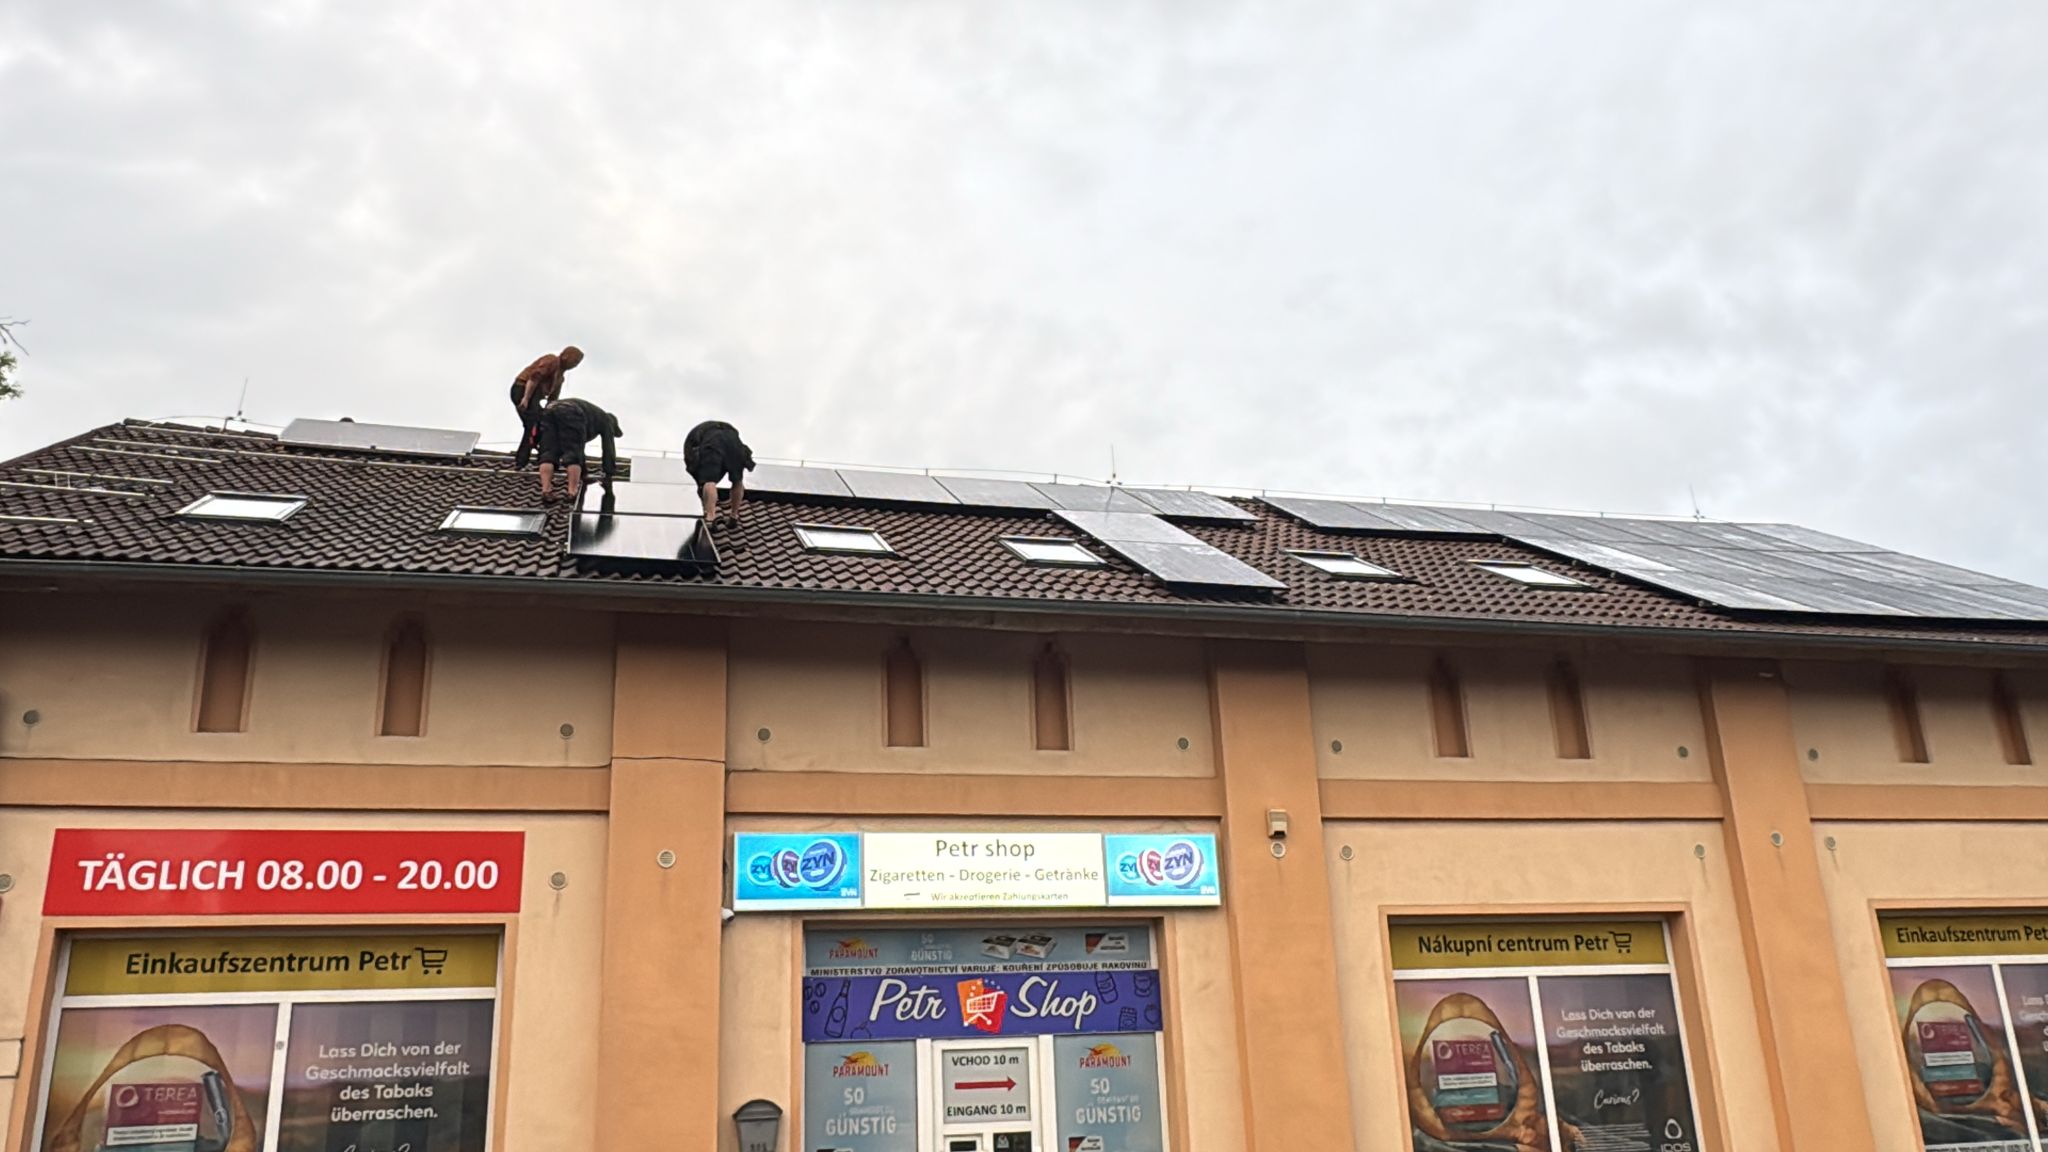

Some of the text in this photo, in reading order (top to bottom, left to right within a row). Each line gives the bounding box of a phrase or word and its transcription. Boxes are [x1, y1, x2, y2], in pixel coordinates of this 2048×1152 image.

[935, 838, 1036, 862] Petr shop
[801, 851, 836, 872] ZYN
[1163, 851, 1194, 871] ZYN
[78, 852, 499, 891] TÄGLICH 08.00 - 20.00
[869, 868, 946, 885] Zigaretten
[959, 868, 1022, 885] Drogerie
[1034, 867, 1099, 882] Getränke
[930, 891, 1069, 902] Wir akzeptieren Zahlungskarten
[1895, 926, 2022, 944] Einkaufszentrum
[829, 947, 879, 960] PARAMOUNT
[1417, 934, 1609, 956] Nákupní centrum Petr
[126, 950, 412, 975] Einkaufszentrum Petr
[810, 960, 1148, 976] MINISTERSTVO ZDRAVOTNICTVÍ VARUJE: KOUŘENÍ ZPŮSOBUJE RAKOVINU
[869, 975, 1098, 1030] Petr Shop
[1561, 1007, 1657, 1021] Lass Dich von der
[1556, 1022, 1666, 1039] Geschmacksvielfalt
[319, 1041, 462, 1059] Lass Dich von der
[1582, 1040, 1646, 1055] des Tabaks
[951, 1054, 1020, 1067] VCHOD 10 m
[1079, 1055, 1131, 1069] PARAMOUNT
[1580, 1058, 1653, 1072] überraschen.
[305, 1060, 471, 1081] Geschmacksvielfalt
[833, 1063, 889, 1078] PARAMOUNT
[144, 1087, 198, 1101] TEREA
[339, 1082, 434, 1101] des Tabaks
[330, 1104, 439, 1122] überraschen.
[946, 1103, 1027, 1117] EINGANG 10 m
[1075, 1102, 1141, 1124] GÜNSTIG
[825, 1113, 897, 1136] GÜNSTIG
